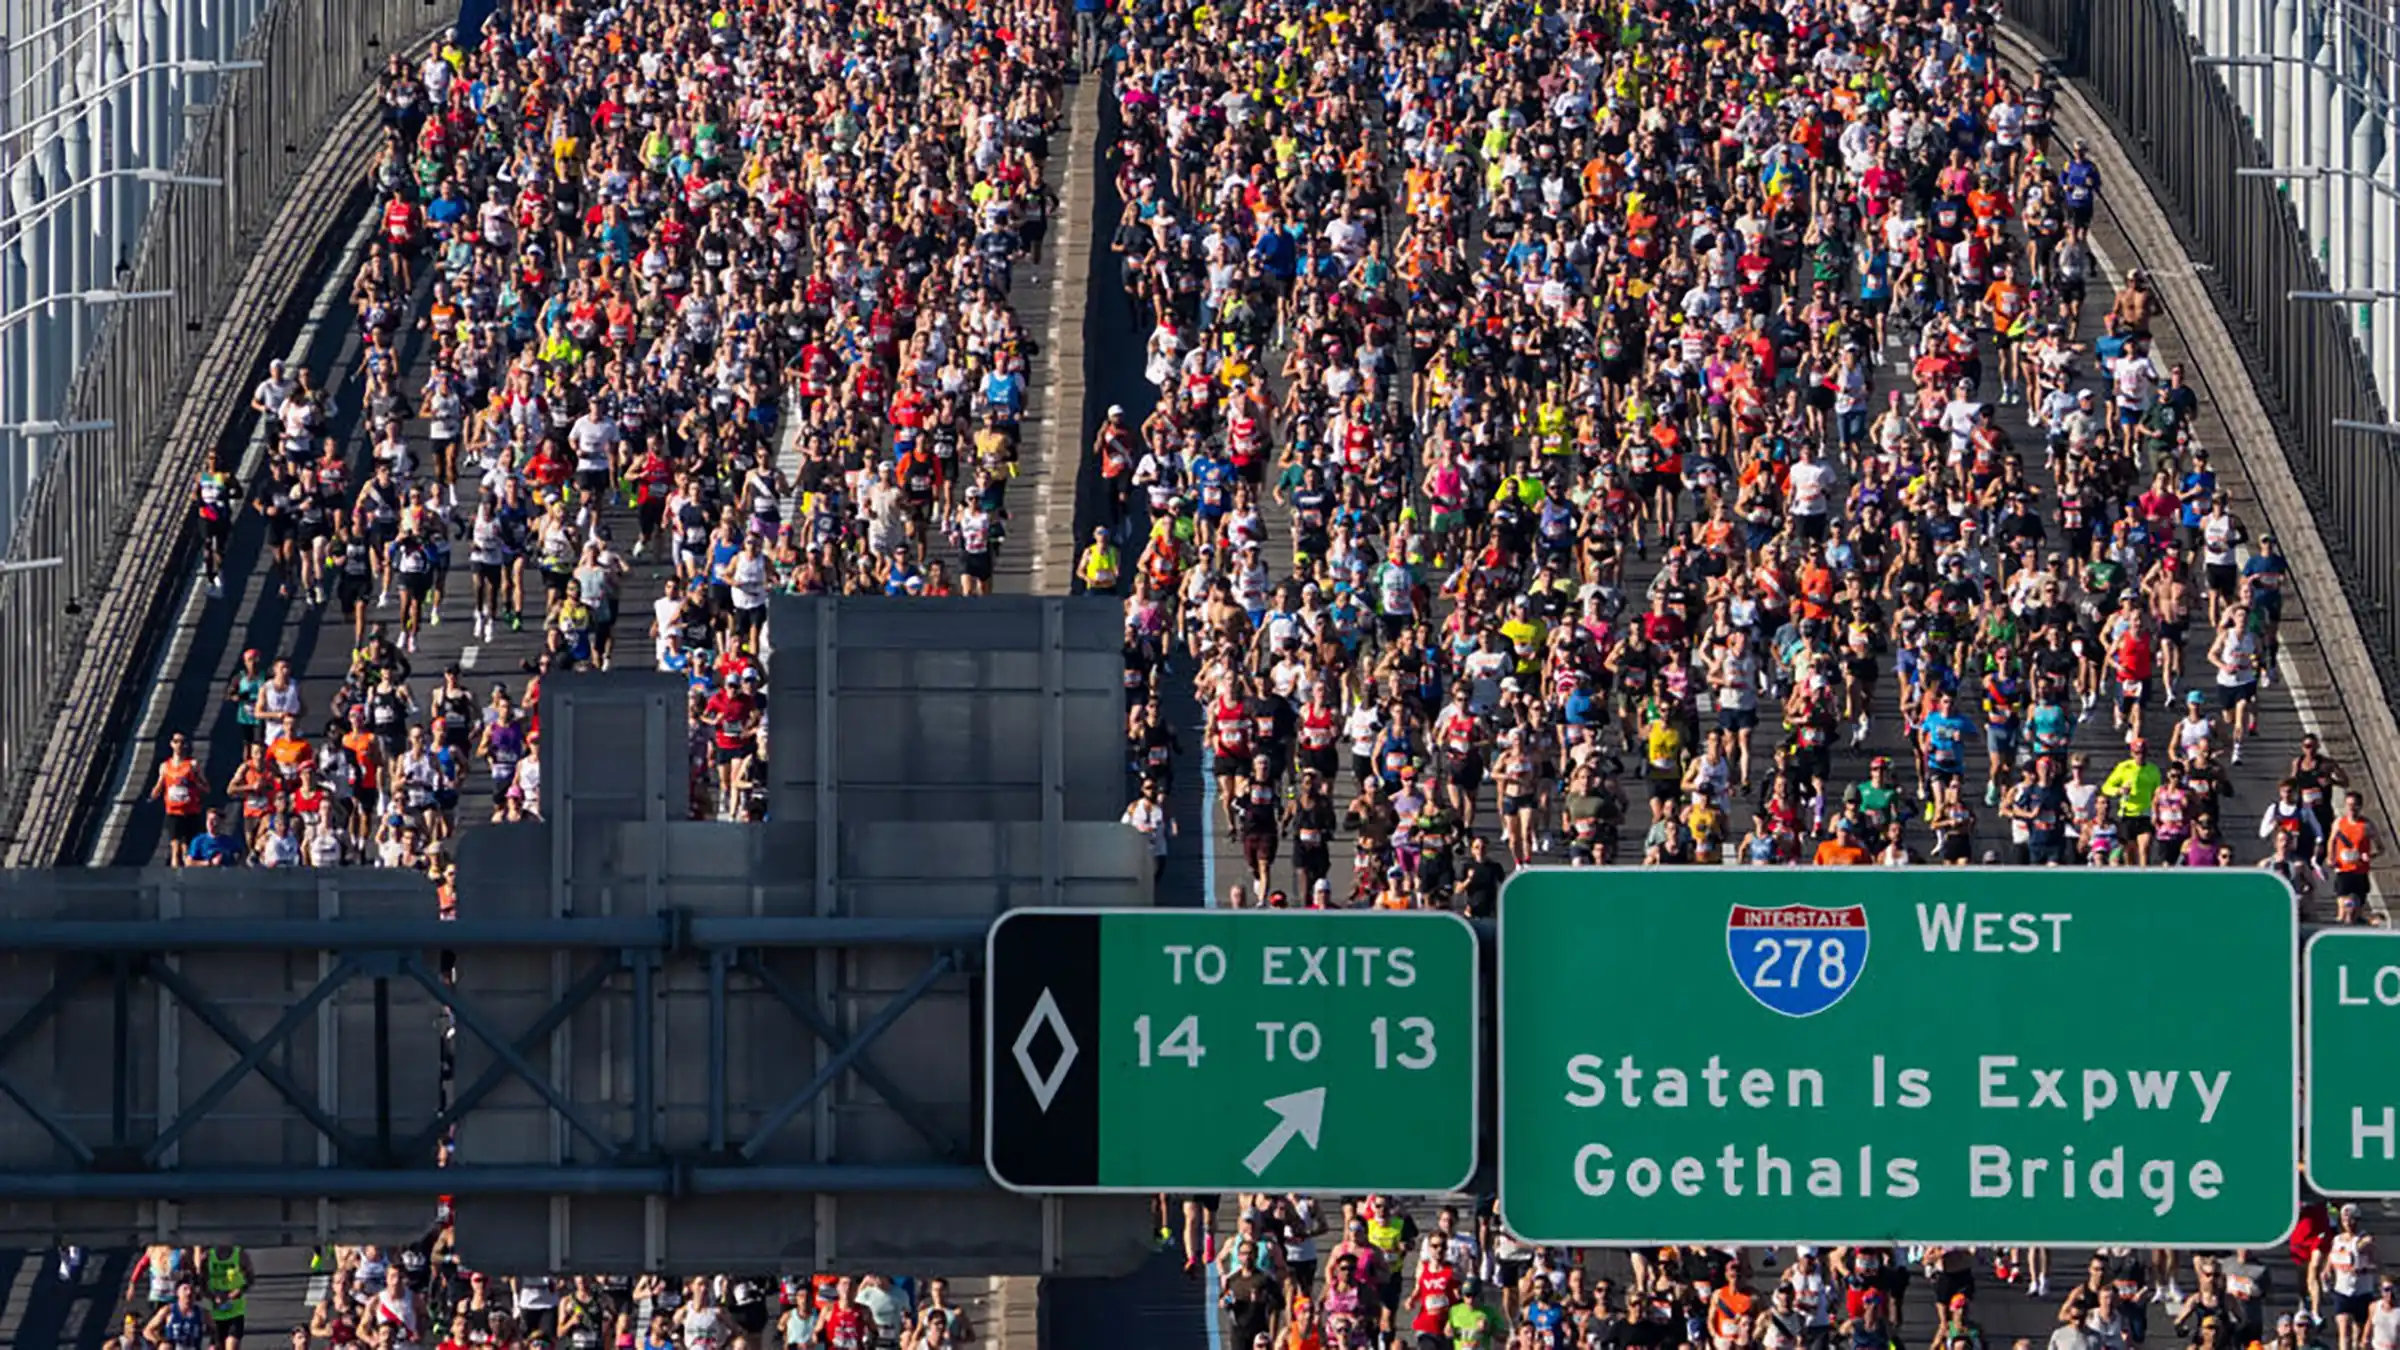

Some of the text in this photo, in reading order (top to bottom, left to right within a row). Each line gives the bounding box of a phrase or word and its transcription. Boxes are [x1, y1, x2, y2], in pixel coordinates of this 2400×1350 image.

[1744, 910, 1851, 926] INTERSTATE
[1163, 944, 1416, 988] TO EXITS
[1752, 937, 1847, 989] 278
[1133, 1014, 1437, 1070] 14 TO 13
[1564, 1054, 2231, 1123] Staten Is Expwy
[1573, 1143, 2225, 1217] Goethals Bridge
